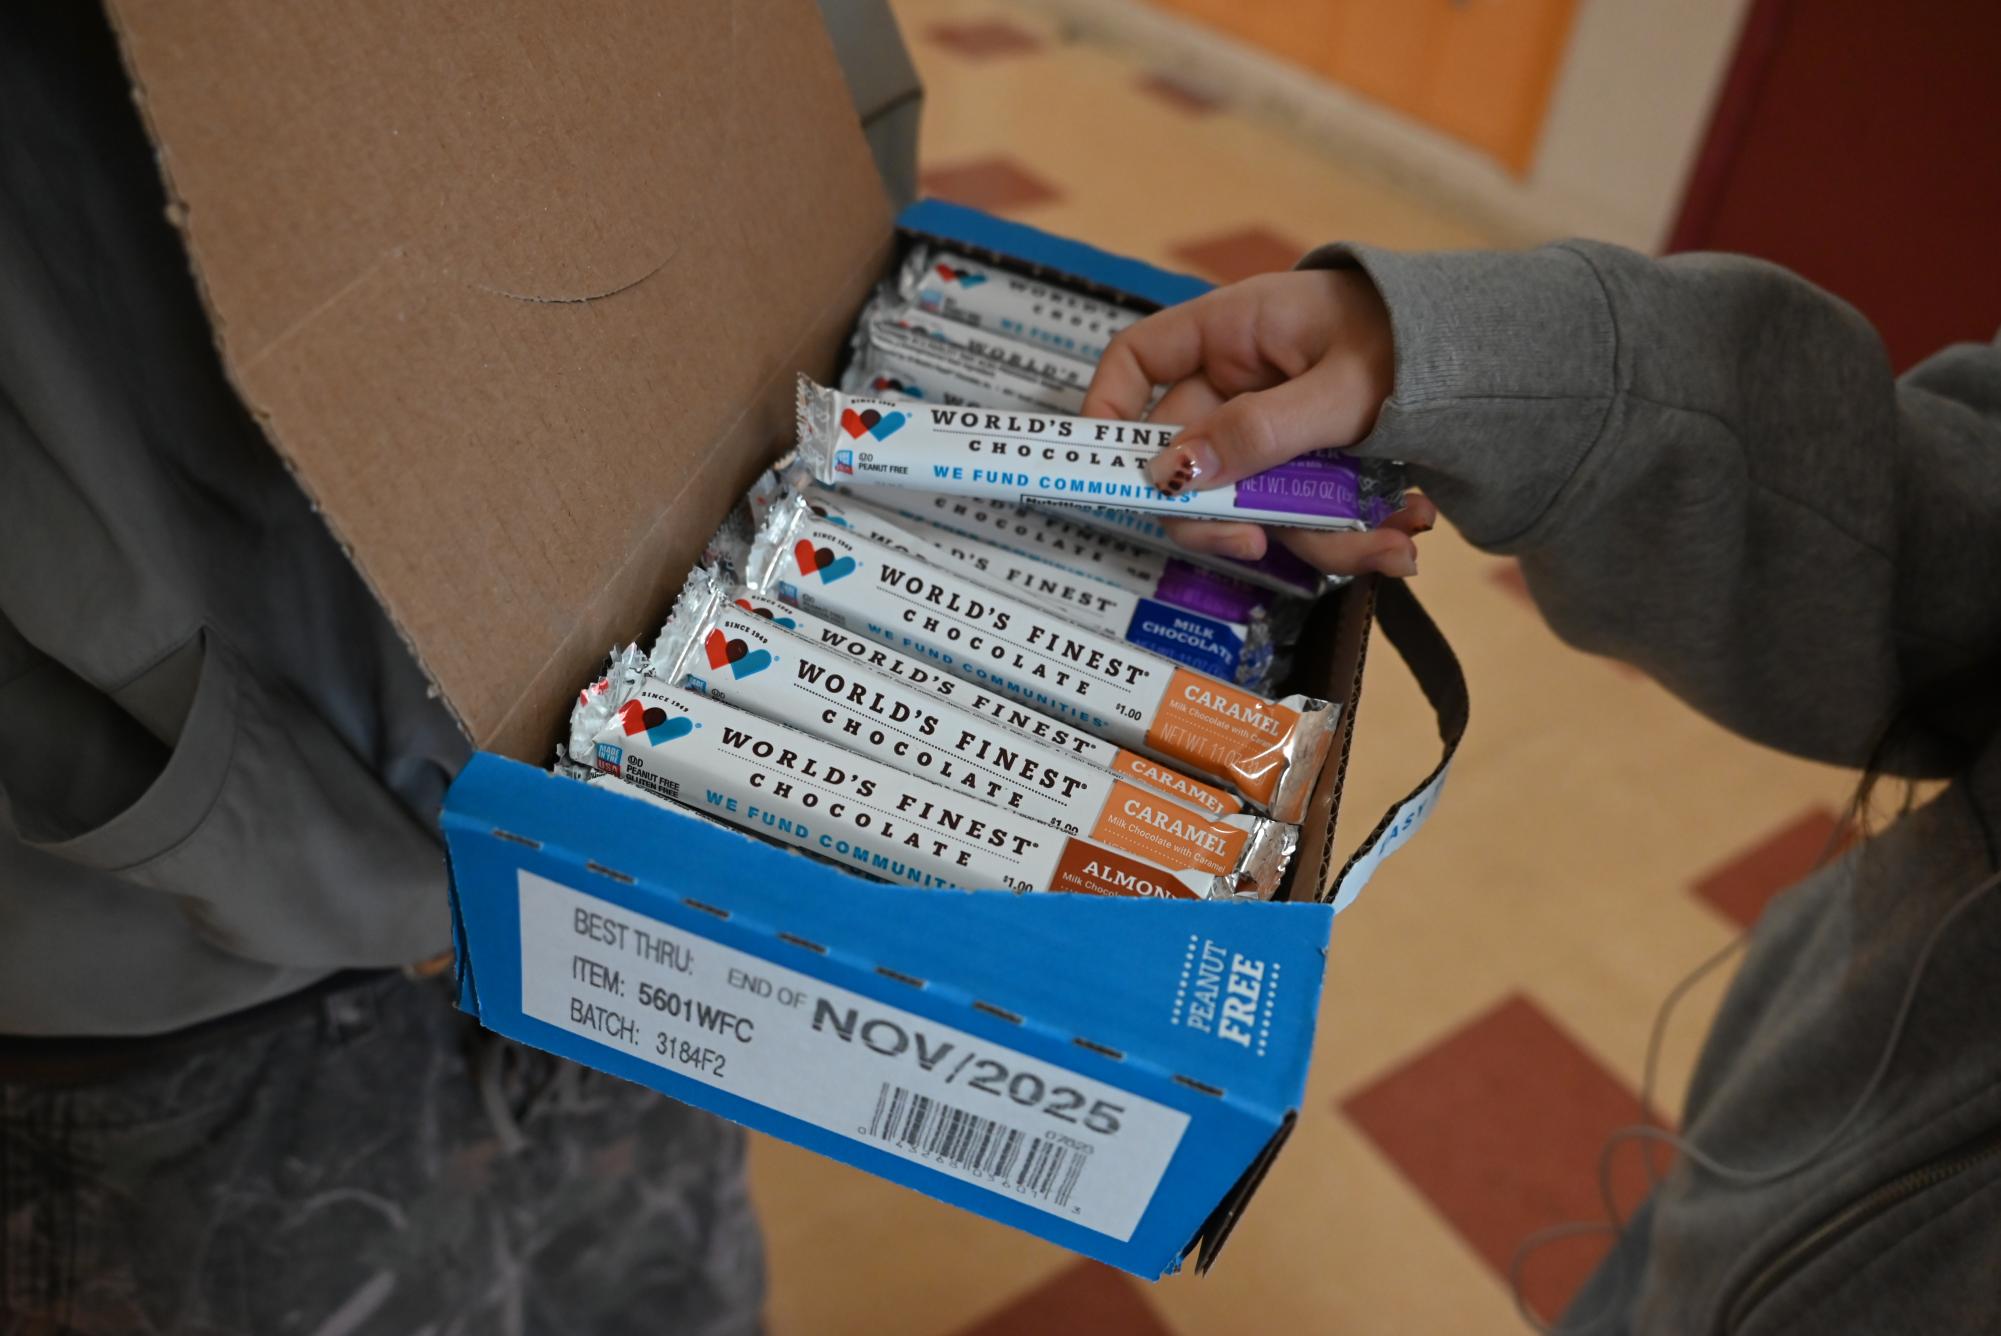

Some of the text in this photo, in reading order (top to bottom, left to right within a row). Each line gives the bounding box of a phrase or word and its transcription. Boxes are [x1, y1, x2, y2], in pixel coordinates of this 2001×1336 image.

[931, 409, 1173, 447] WORLD'S FINE
[858, 462, 887, 473] PEANUT
[889, 464, 909, 475] FREE
[933, 465, 963, 480] WE
[972, 469, 1029, 487] FUND
[968, 440, 1149, 469] CHOCOLAT
[1242, 477, 1265, 493] NET
[1267, 477, 1289, 496] WT.
[1291, 478, 1318, 498] 0.67
[1319, 480, 1336, 500] OZ
[935, 496, 1105, 562] CHOCOLATE
[1006, 568, 1112, 612] FINEST
[724, 620, 751, 634] SINCE
[879, 563, 1011, 631] WORLD'S
[1027, 625, 1143, 685] FINEST
[1173, 617, 1215, 640] MILK
[868, 623, 1103, 728] WE FUND COMMUNITIES
[903, 609, 1090, 696] CHOCOLATE
[641, 691, 669, 703] SINCE
[821, 628, 1090, 754] WORLD'S FINEST
[1115, 703, 1142, 721] $1.00
[1184, 685, 1280, 737] CARAMEL
[797, 659, 1082, 798] WORLD'S FINEST
[1169, 699, 1187, 713] Milk
[1189, 707, 1231, 731] Chocolate
[1232, 723, 1250, 738] with
[626, 765, 680, 791] PEANUT FREE
[821, 709, 1024, 809] CHOCOLATE
[625, 774, 679, 798] GLUTEN FREE
[721, 726, 1032, 856] WORLD'S FINEST
[706, 789, 738, 812] WE
[748, 806, 808, 838] FUND
[750, 773, 972, 867] CHOCOLATE
[1123, 799, 1227, 857] CARAMEL
[1107, 814, 1128, 830] Milk
[1128, 824, 1172, 849] Chocolate
[1173, 843, 1192, 858] with
[1193, 853, 1226, 873] Caramel
[1003, 875, 1033, 893] $1.00
[1062, 872, 1083, 885] Milk
[1082, 861, 1178, 899] ALMON
[573, 907, 695, 976] BEST THRU:
[572, 955, 755, 1043] ITEM: 5601WFC
[1187, 940, 1228, 1034] PEANUT
[1218, 953, 1265, 1048] FREE
[570, 997, 726, 1078] BATCH: 3184F2
[727, 967, 1126, 1136] END OF NOV/2025
